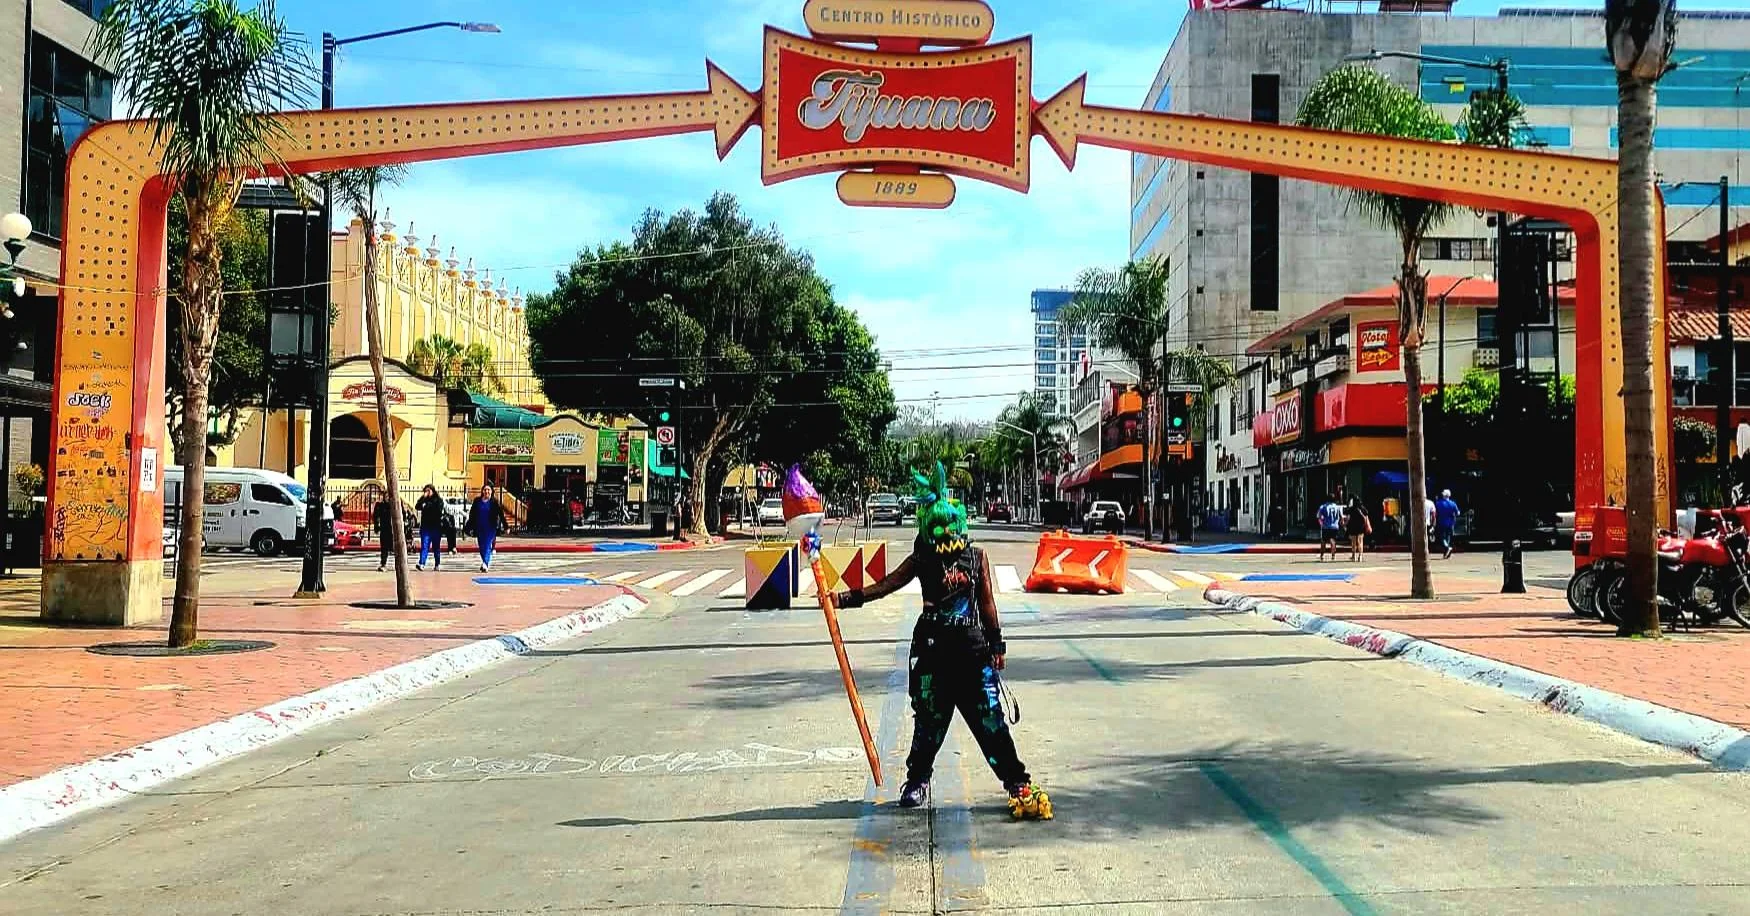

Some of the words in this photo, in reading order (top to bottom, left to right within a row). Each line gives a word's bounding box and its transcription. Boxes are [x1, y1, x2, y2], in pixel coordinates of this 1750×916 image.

[820, 6, 884, 25] CENTRO
[891, 8, 981, 28] HISTÓRICO
[797, 70, 996, 142] Tijuana
[873, 180, 918, 196] 1889
[1274, 396, 1299, 435] OXXO
